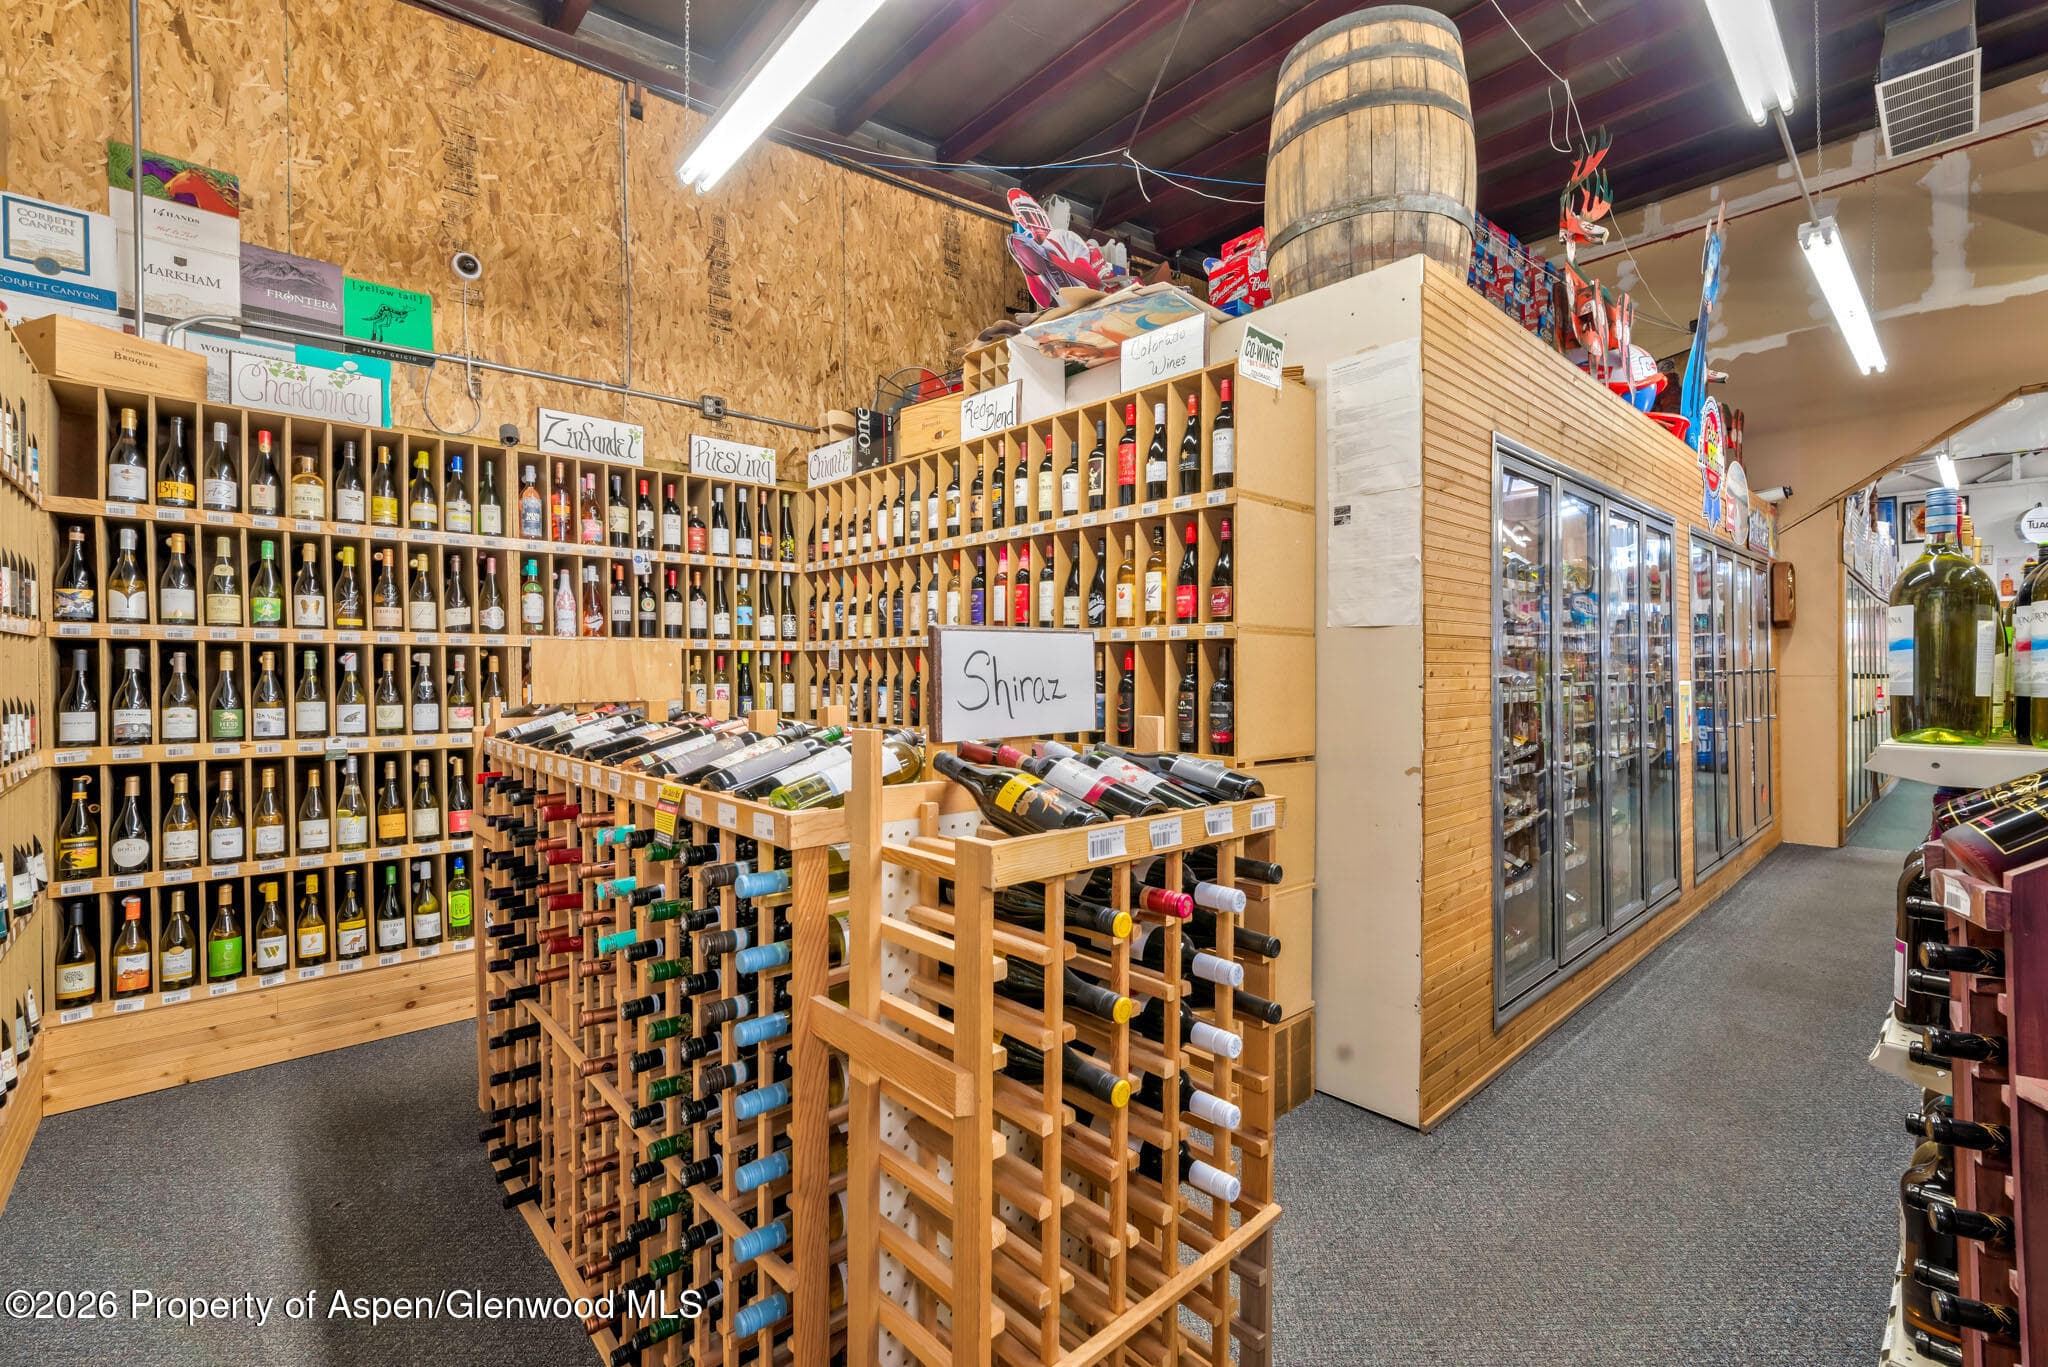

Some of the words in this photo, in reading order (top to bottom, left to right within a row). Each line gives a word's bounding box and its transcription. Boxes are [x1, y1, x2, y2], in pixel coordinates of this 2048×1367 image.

[17, 207, 76, 227] CORBETT
[18, 217, 75, 236] CANYON
[166, 212, 200, 224] HANDS
[143, 263, 221, 289] MARKHAM
[51, 284, 100, 301] CANYON
[266, 288, 338, 312] FRONTERA
[1130, 328, 1186, 361] Colorado
[1245, 340, 1280, 369] CO-WINES
[1148, 354, 1187, 376] Wines
[237, 360, 373, 424] Chardonnay
[963, 399, 987, 428] Red
[980, 396, 1015, 431] Blend
[544, 413, 637, 459] Zinfandel
[694, 438, 772, 485] Riesling
[957, 650, 1067, 719] Shiraz
